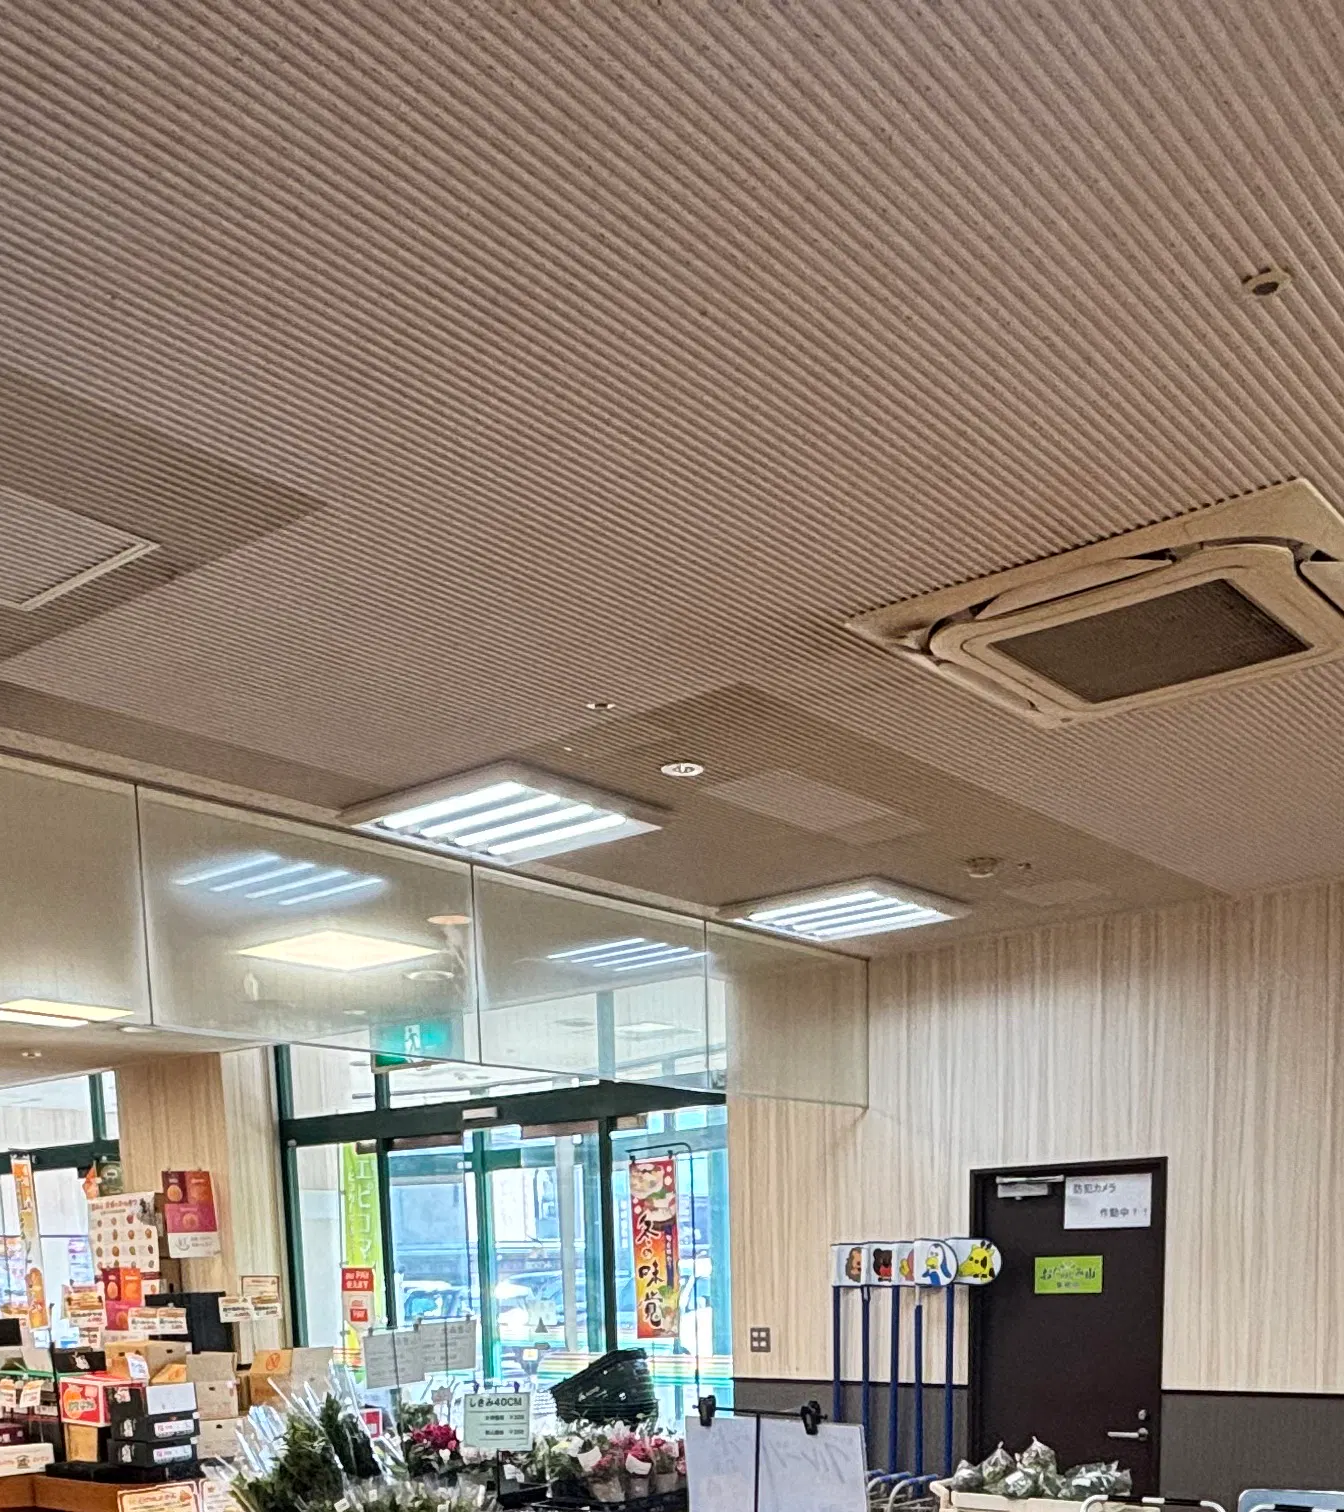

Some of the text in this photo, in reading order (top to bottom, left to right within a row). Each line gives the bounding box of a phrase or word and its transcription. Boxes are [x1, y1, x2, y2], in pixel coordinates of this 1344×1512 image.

[1072, 1182, 1117, 1195] 防犯カメラ
[636, 1211, 664, 1328] 冬の味覚
